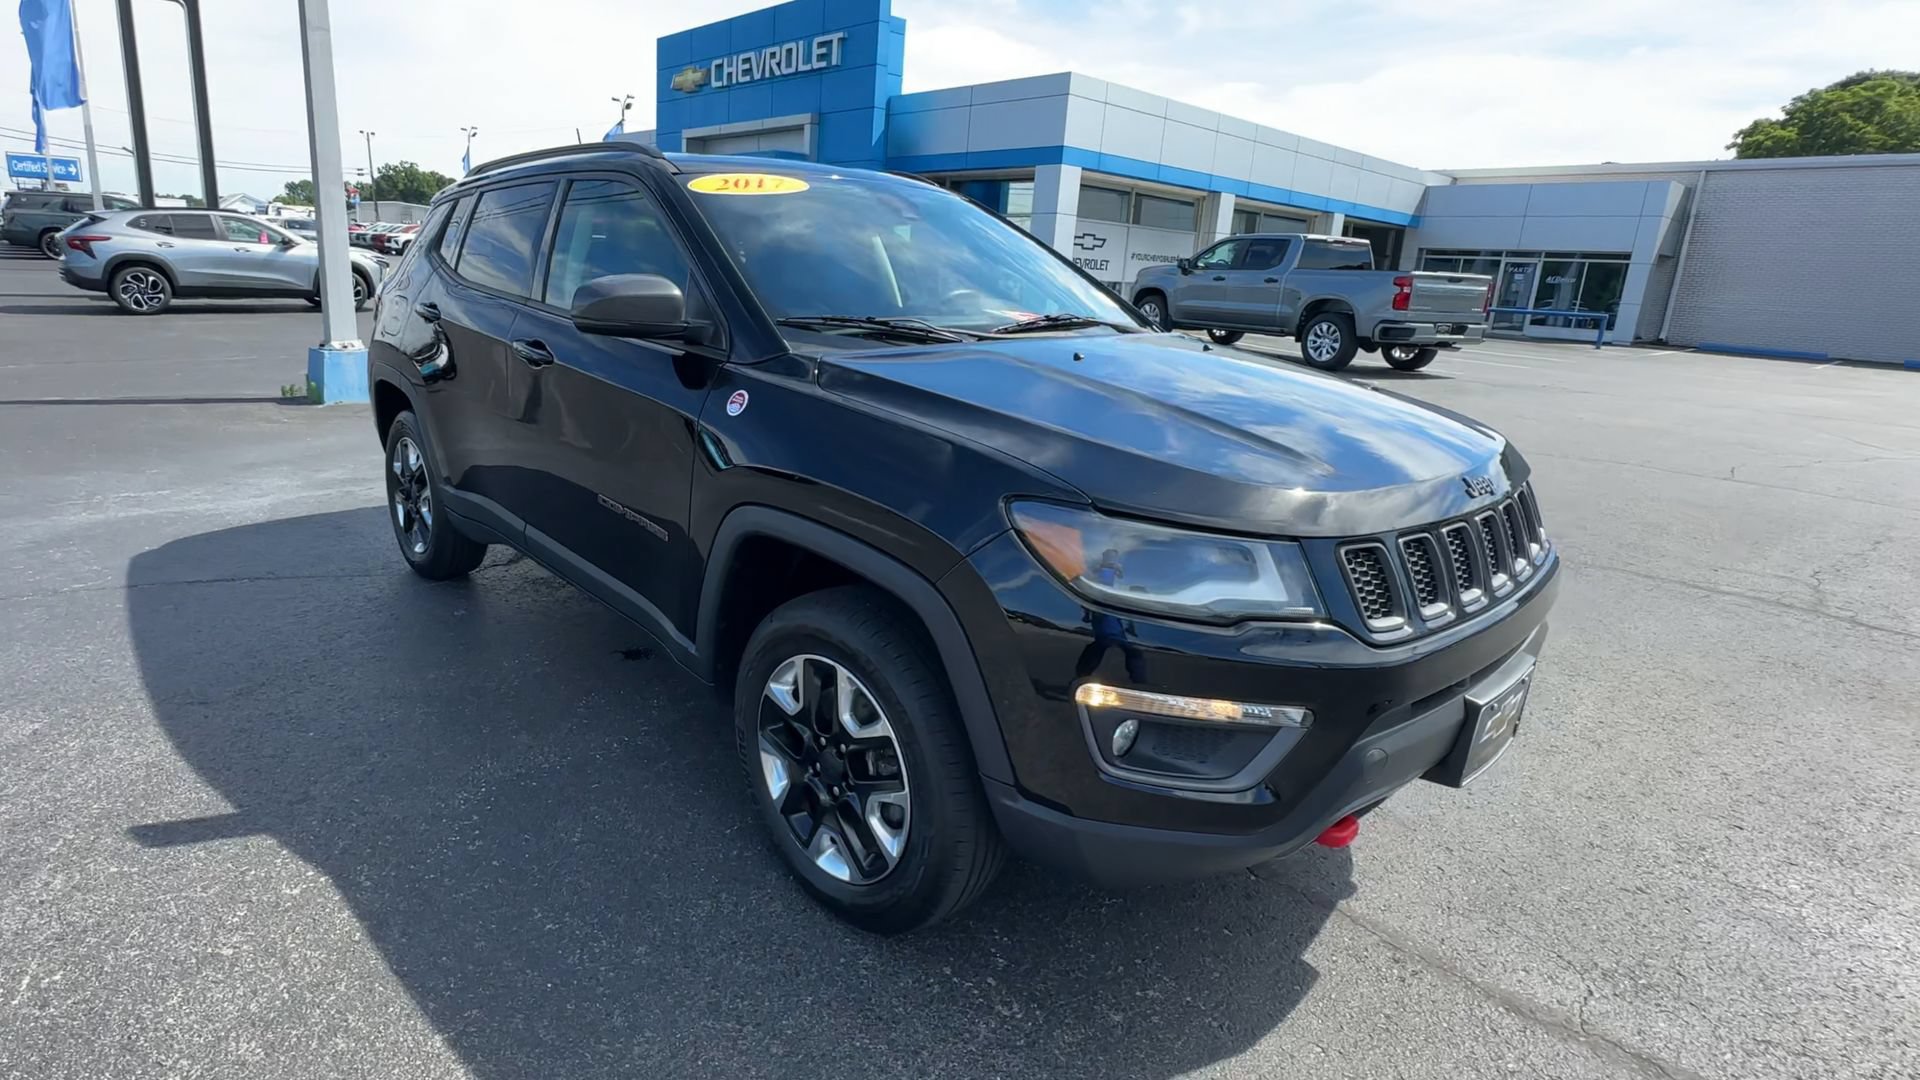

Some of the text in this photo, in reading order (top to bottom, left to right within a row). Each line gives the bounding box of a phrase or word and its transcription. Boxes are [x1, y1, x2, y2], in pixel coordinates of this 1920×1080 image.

[710, 32, 847, 88] CHEVROLET
[12, 160, 66, 175] Certified Svice
[715, 178, 785, 191] 2017
[1073, 257, 1110, 272] EVROLET
[1462, 475, 1496, 498] Jeep
